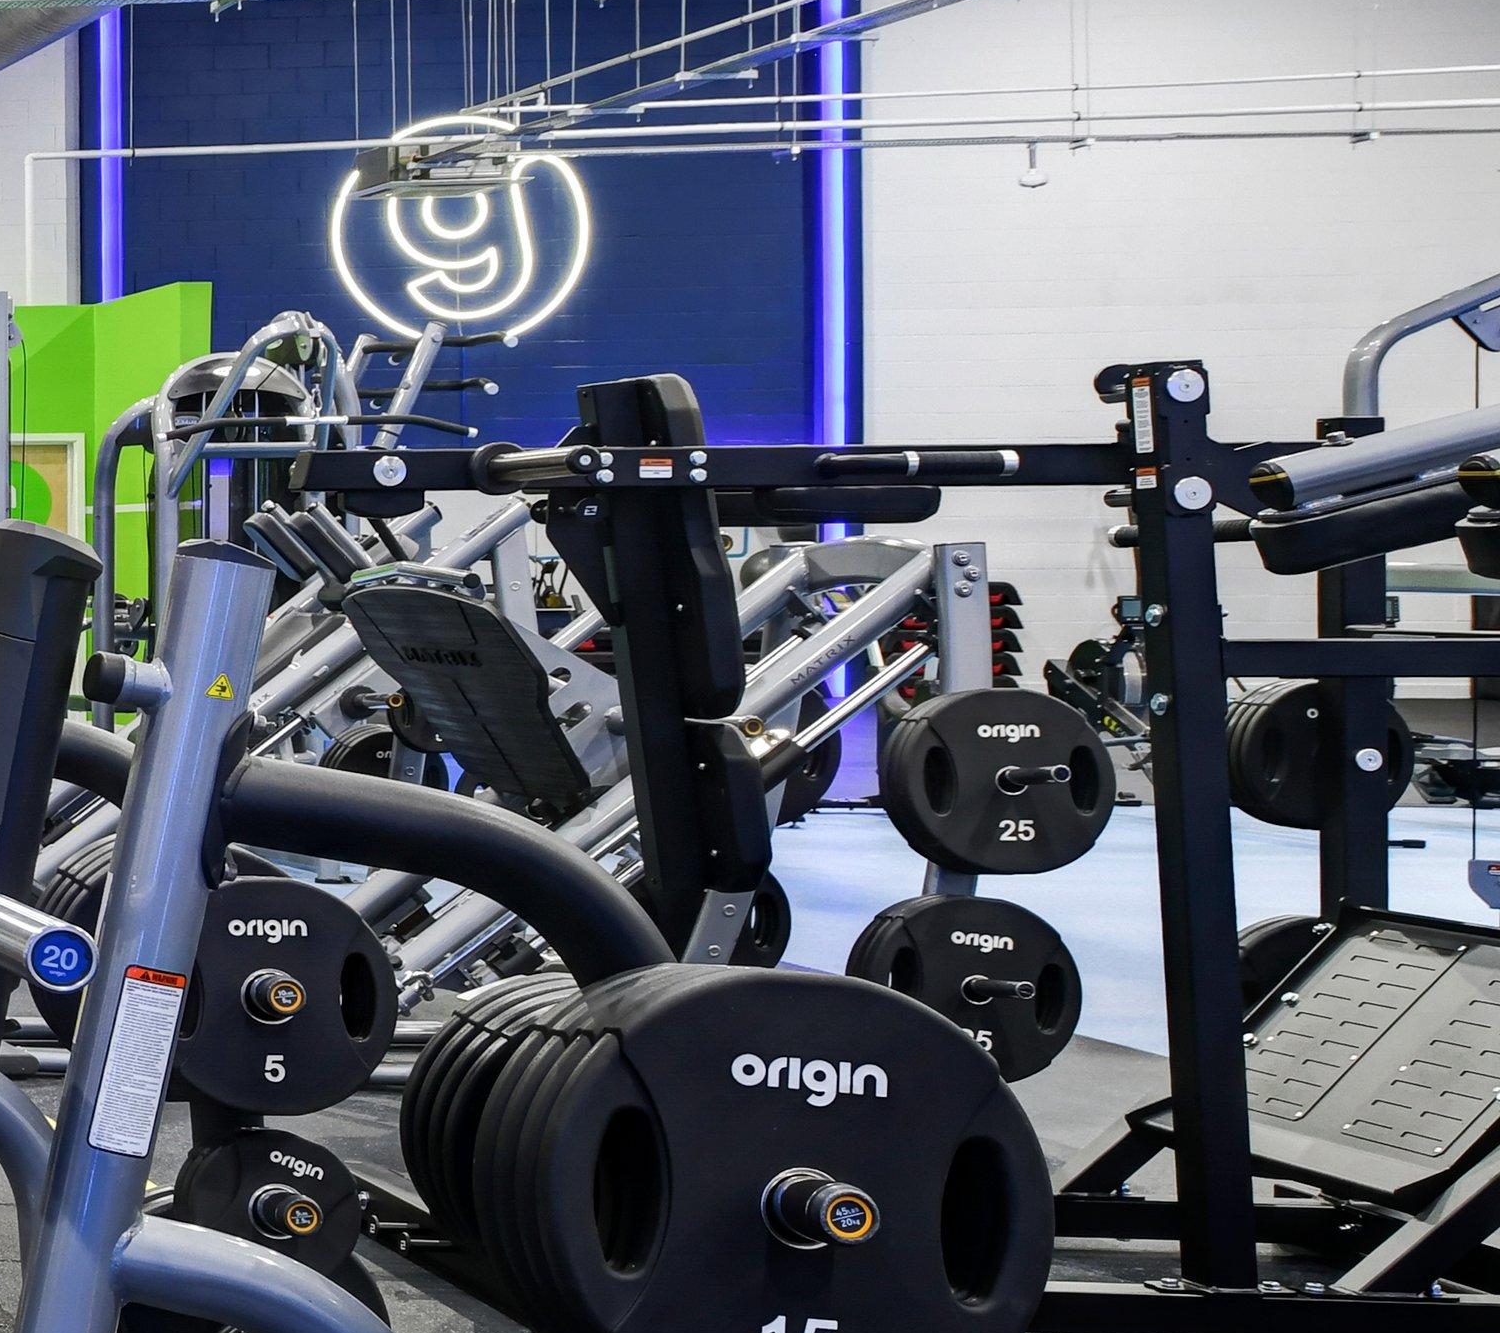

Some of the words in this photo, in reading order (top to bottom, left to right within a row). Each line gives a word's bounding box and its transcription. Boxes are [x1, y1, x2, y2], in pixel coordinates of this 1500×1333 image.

[791, 635, 856, 685] MATRIX
[977, 722, 1041, 744] origin
[999, 819, 1036, 842] 25
[228, 917, 308, 945] origin
[950, 930, 1014, 953] origin
[41, 945, 79, 971] 20
[264, 1054, 286, 1083] 5
[731, 1052, 888, 1108] origin
[269, 1150, 324, 1180] origin
